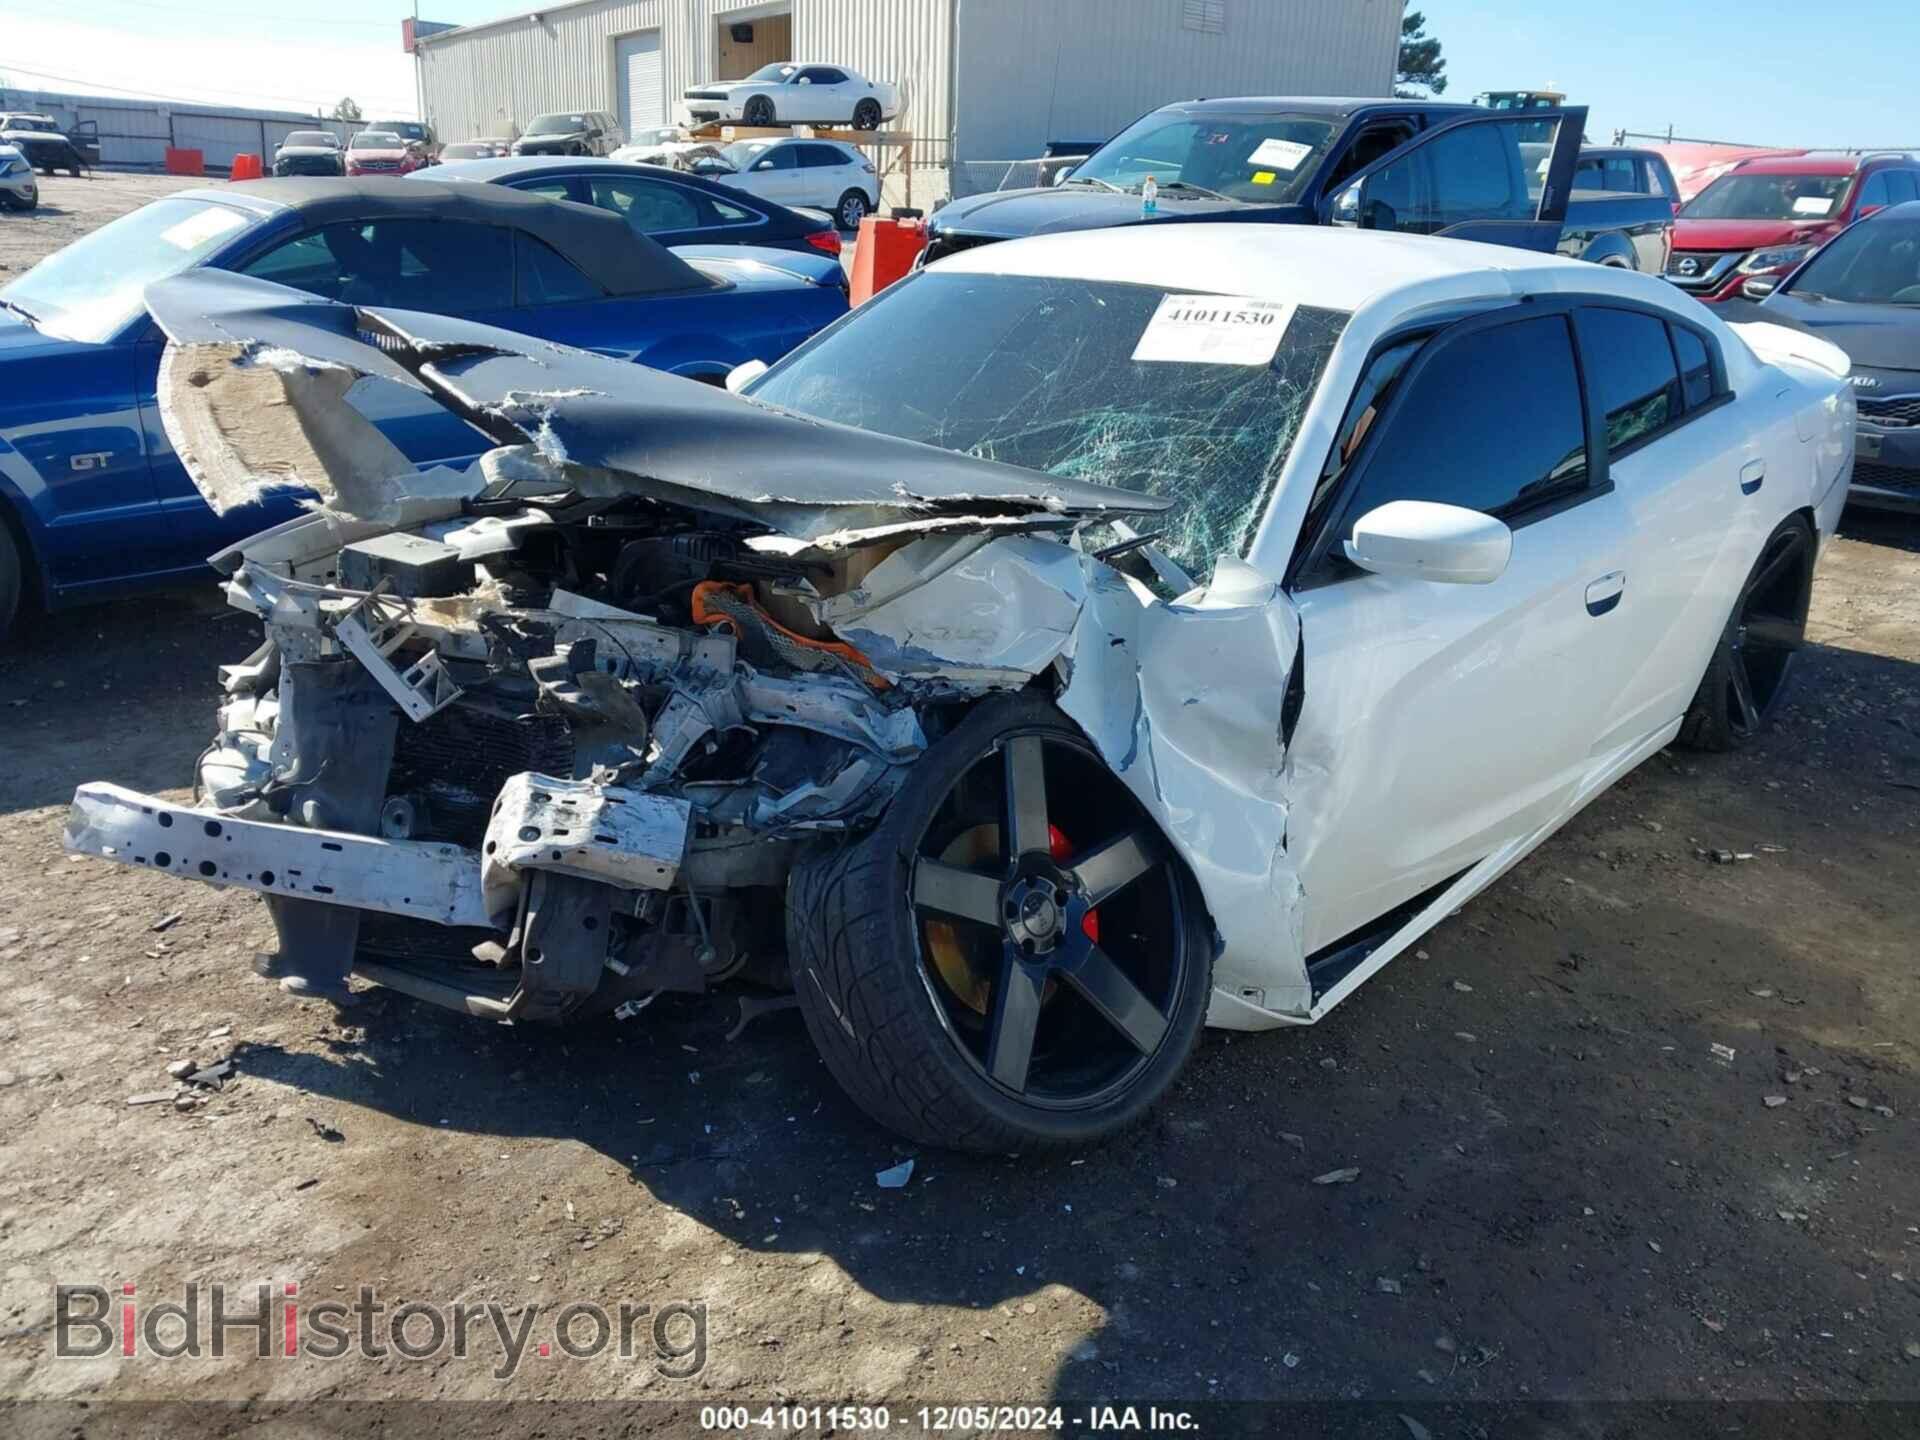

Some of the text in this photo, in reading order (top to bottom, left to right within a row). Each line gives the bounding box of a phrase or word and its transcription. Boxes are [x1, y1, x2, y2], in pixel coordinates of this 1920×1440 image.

[1169, 309, 1275, 326] 41011530
[1852, 375, 1877, 387] KIA
[70, 451, 114, 471] GT
